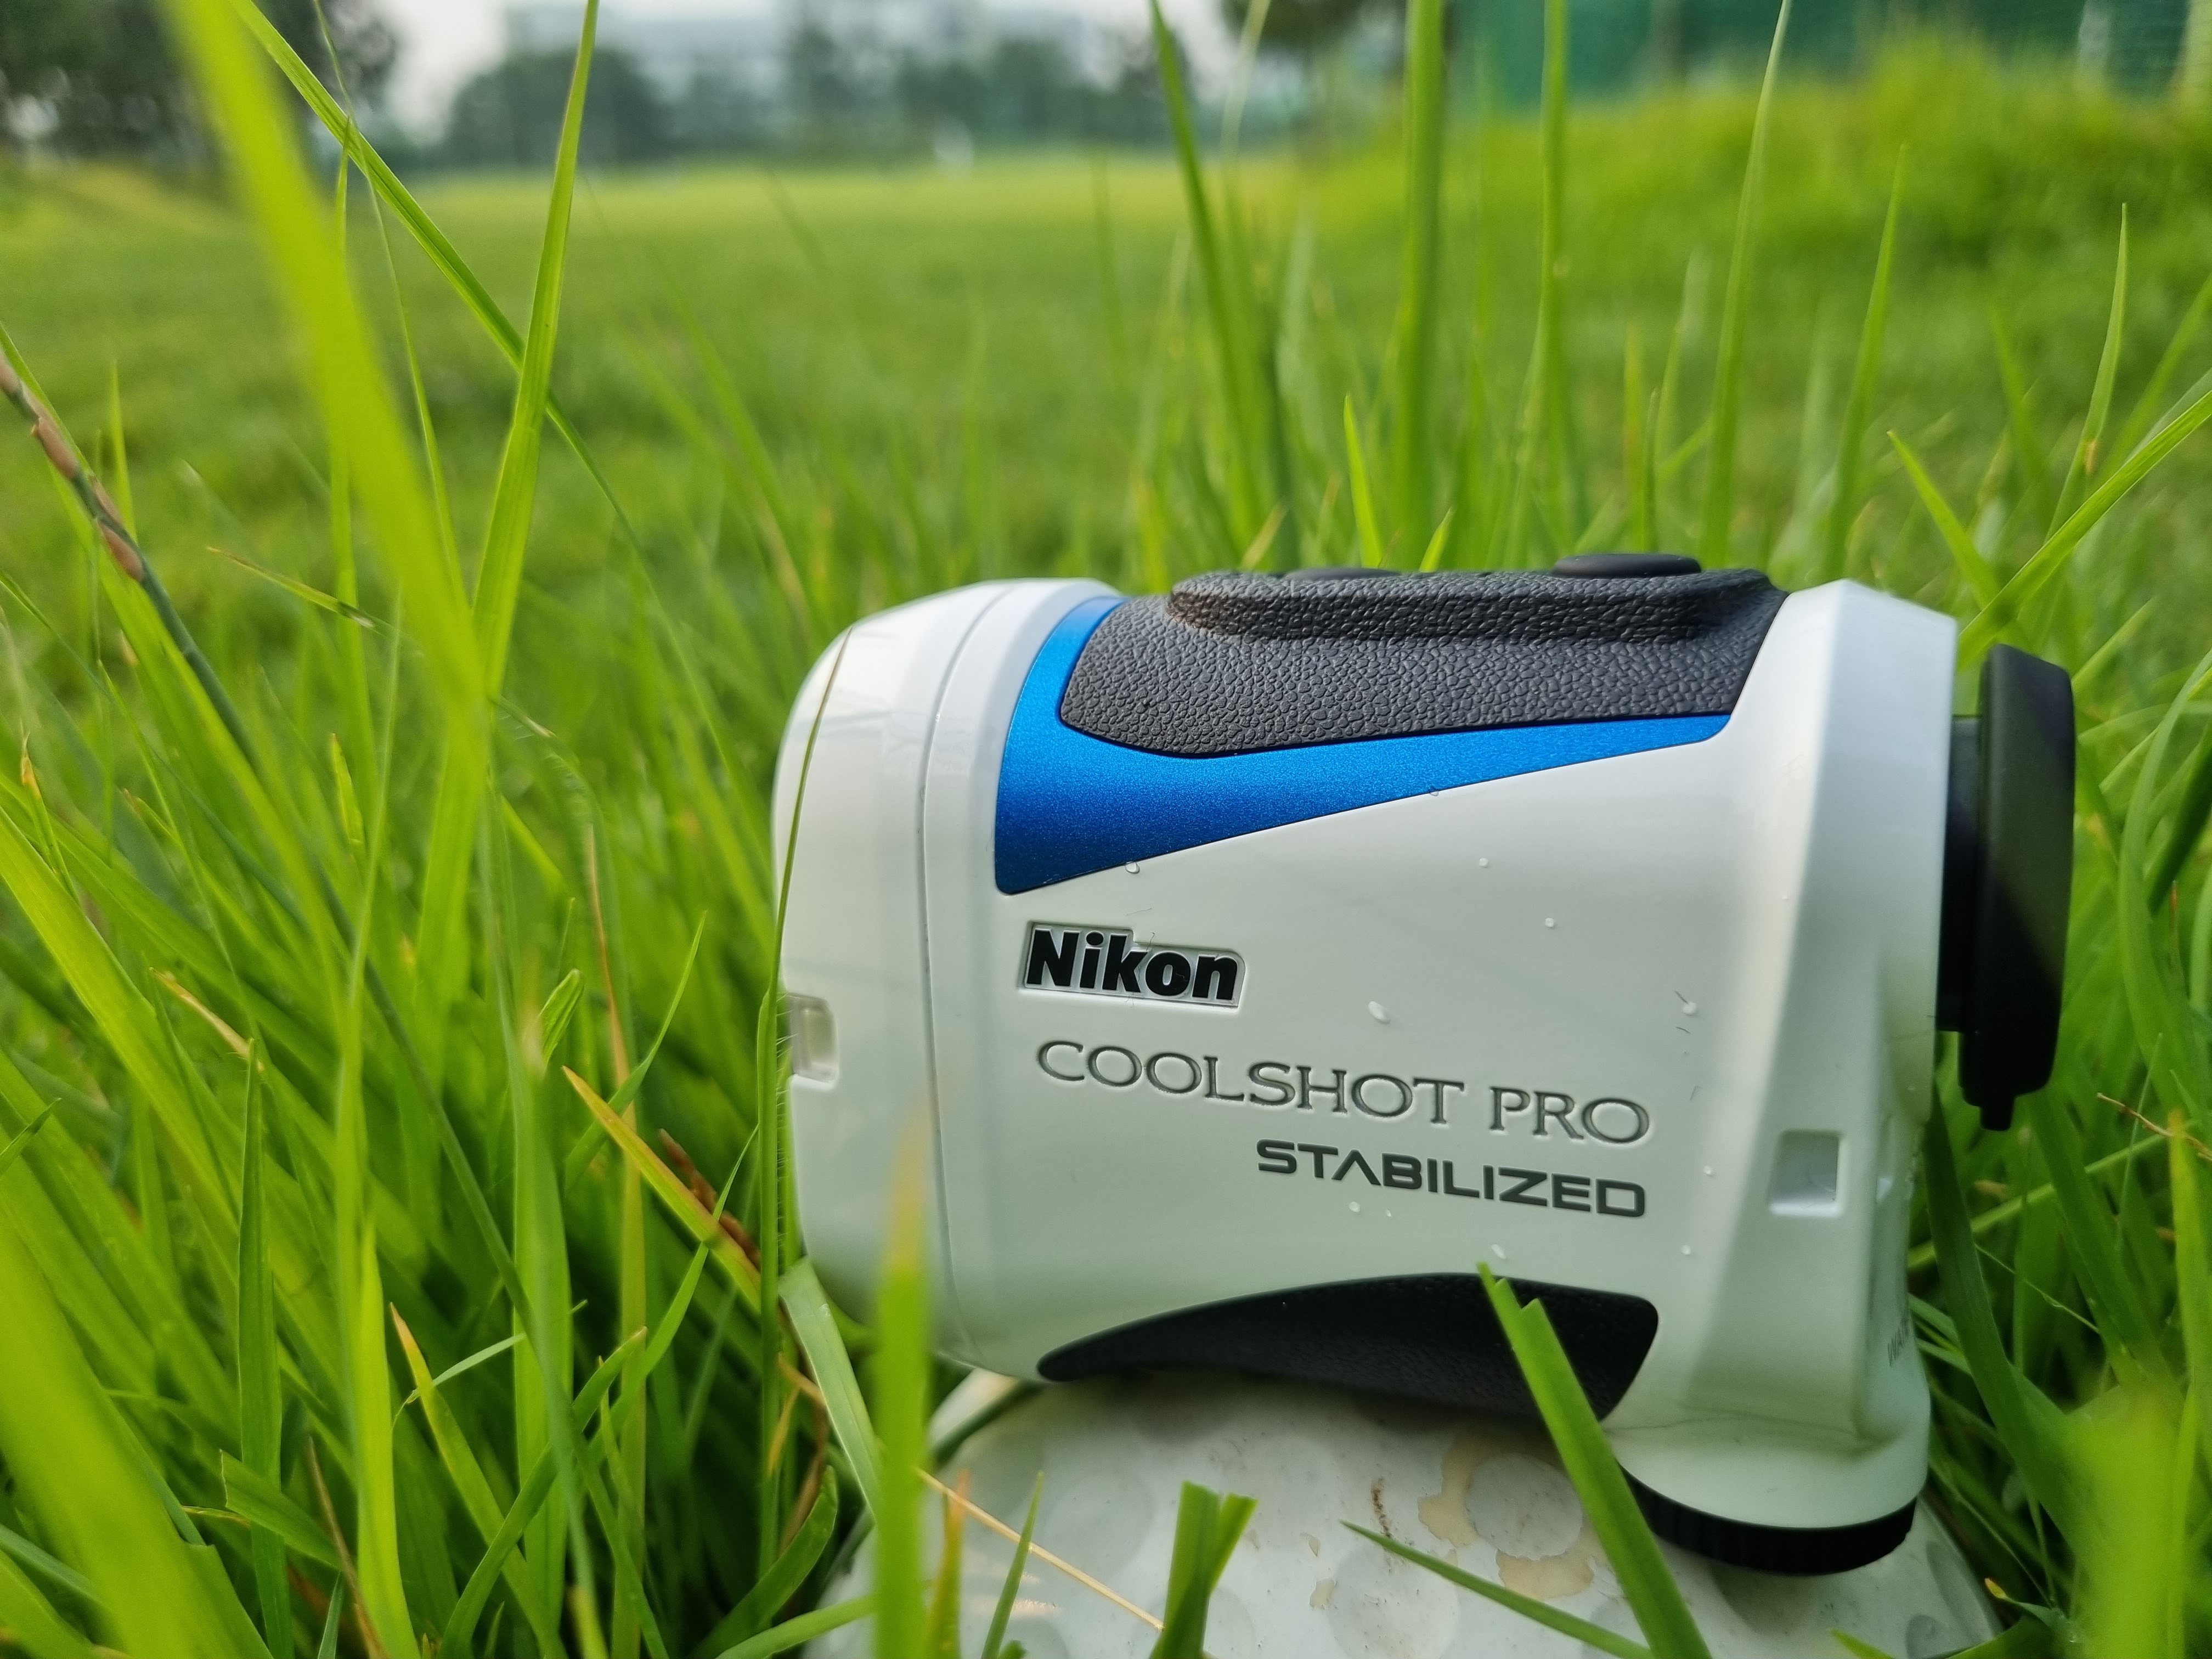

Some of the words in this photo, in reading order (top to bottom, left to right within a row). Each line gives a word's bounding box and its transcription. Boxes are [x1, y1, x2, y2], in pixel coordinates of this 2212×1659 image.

[1026, 929, 1238, 1000] Nikon
[1036, 1040, 1464, 1125] COOLSHOT
[1489, 1086, 1649, 1144] PRO
[1257, 1139, 1645, 1217] STABILIZED
